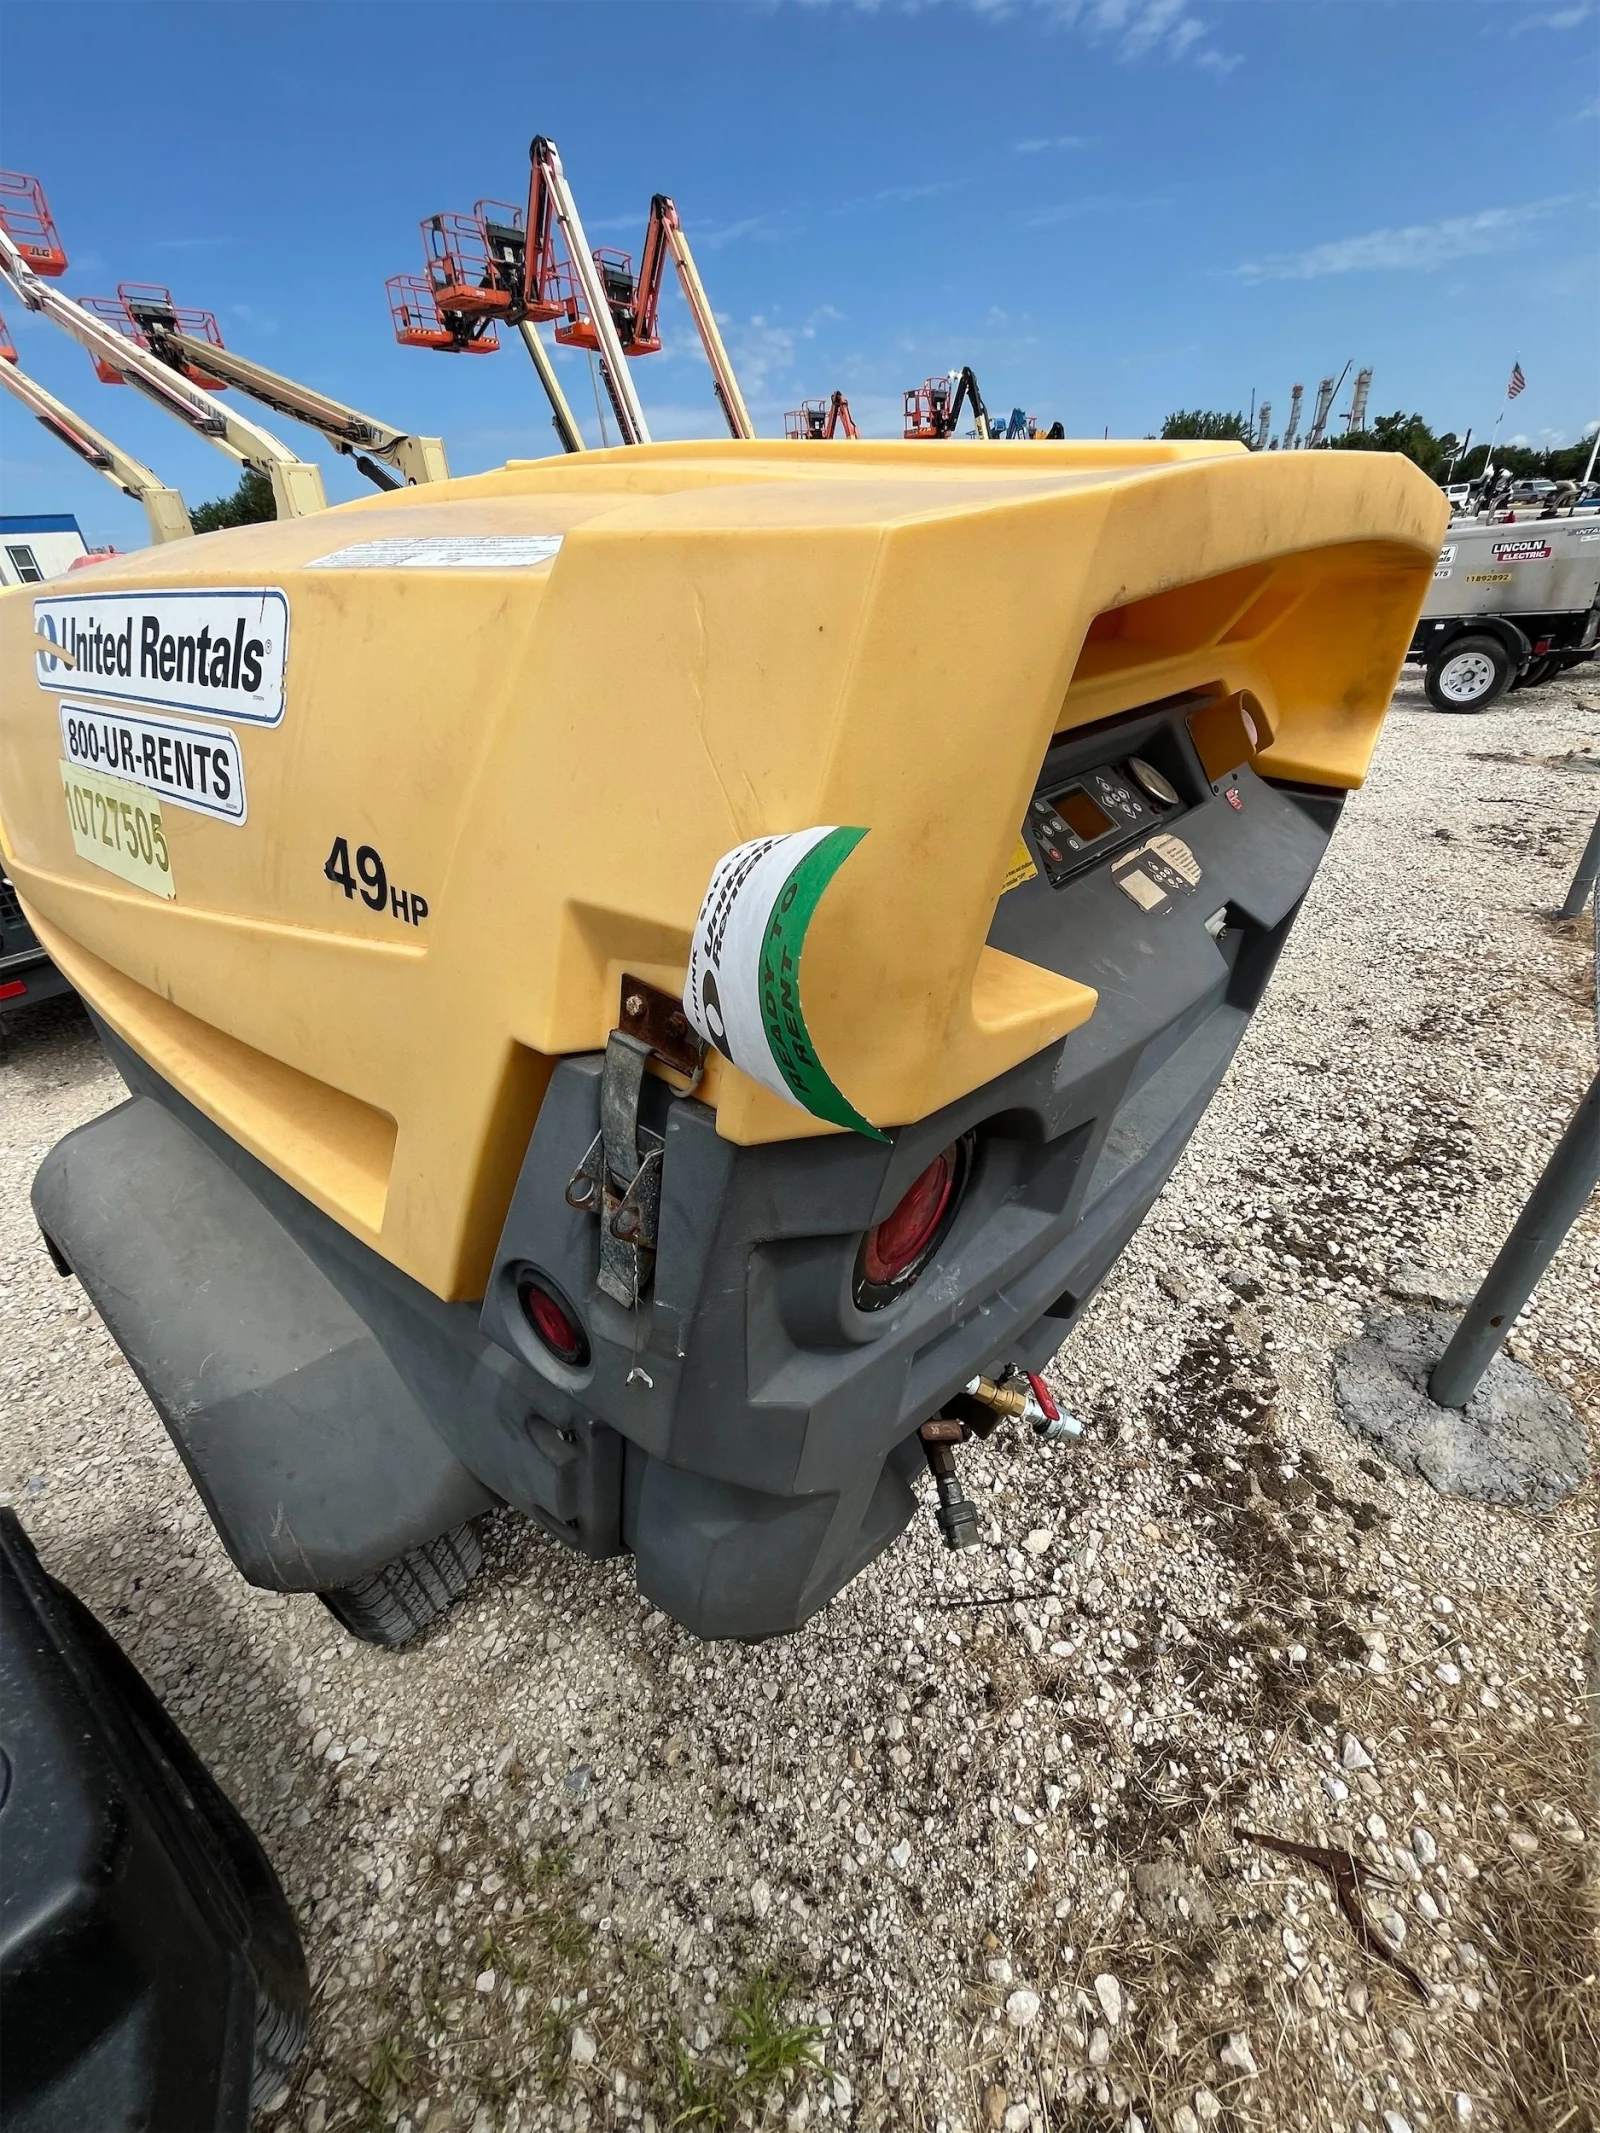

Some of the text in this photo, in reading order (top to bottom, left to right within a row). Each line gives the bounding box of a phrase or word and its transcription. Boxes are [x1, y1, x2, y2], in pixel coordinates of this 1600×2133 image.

[29, 246, 50, 257] JLG
[1466, 574, 1509, 583] 11892892
[1493, 541, 1543, 554] LINCOLN
[1502, 551, 1546, 560] ELECTRIC
[62, 616, 133, 677] United
[68, 718, 231, 800] 800-UR-RENTS
[65, 781, 169, 872] 10727505
[703, 839, 773, 958] United
[712, 835, 793, 969] Rental
[691, 949, 702, 1024] THINK
[763, 882, 811, 1094] READY TO
[779, 944, 815, 1068] RENT
